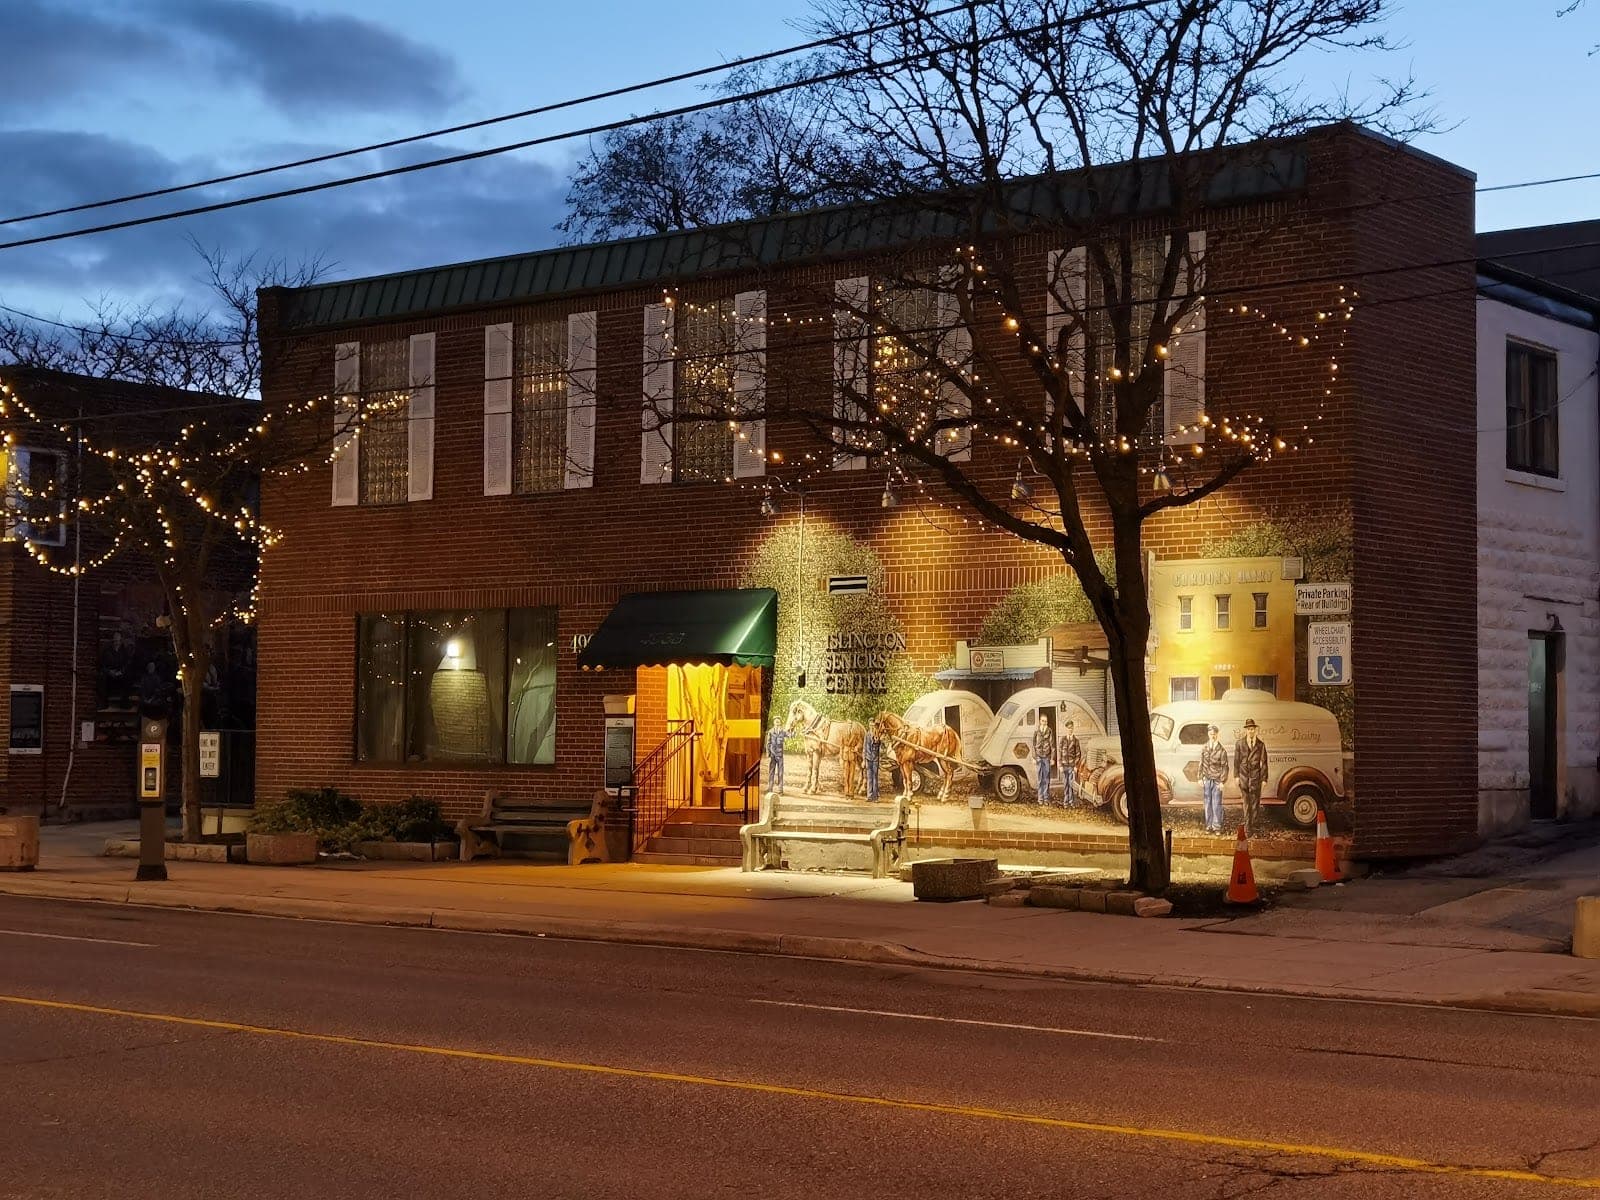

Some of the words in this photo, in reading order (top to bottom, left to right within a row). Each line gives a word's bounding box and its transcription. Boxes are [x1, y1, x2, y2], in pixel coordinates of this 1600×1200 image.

[1298, 589, 1322, 599] Private
[1322, 588, 1348, 600] Parking
[1321, 599, 1348, 611] Building
[1313, 626, 1345, 635] WHEELCHAIR
[827, 632, 906, 650] ISLINGTON
[826, 672, 888, 691] CENTRE
